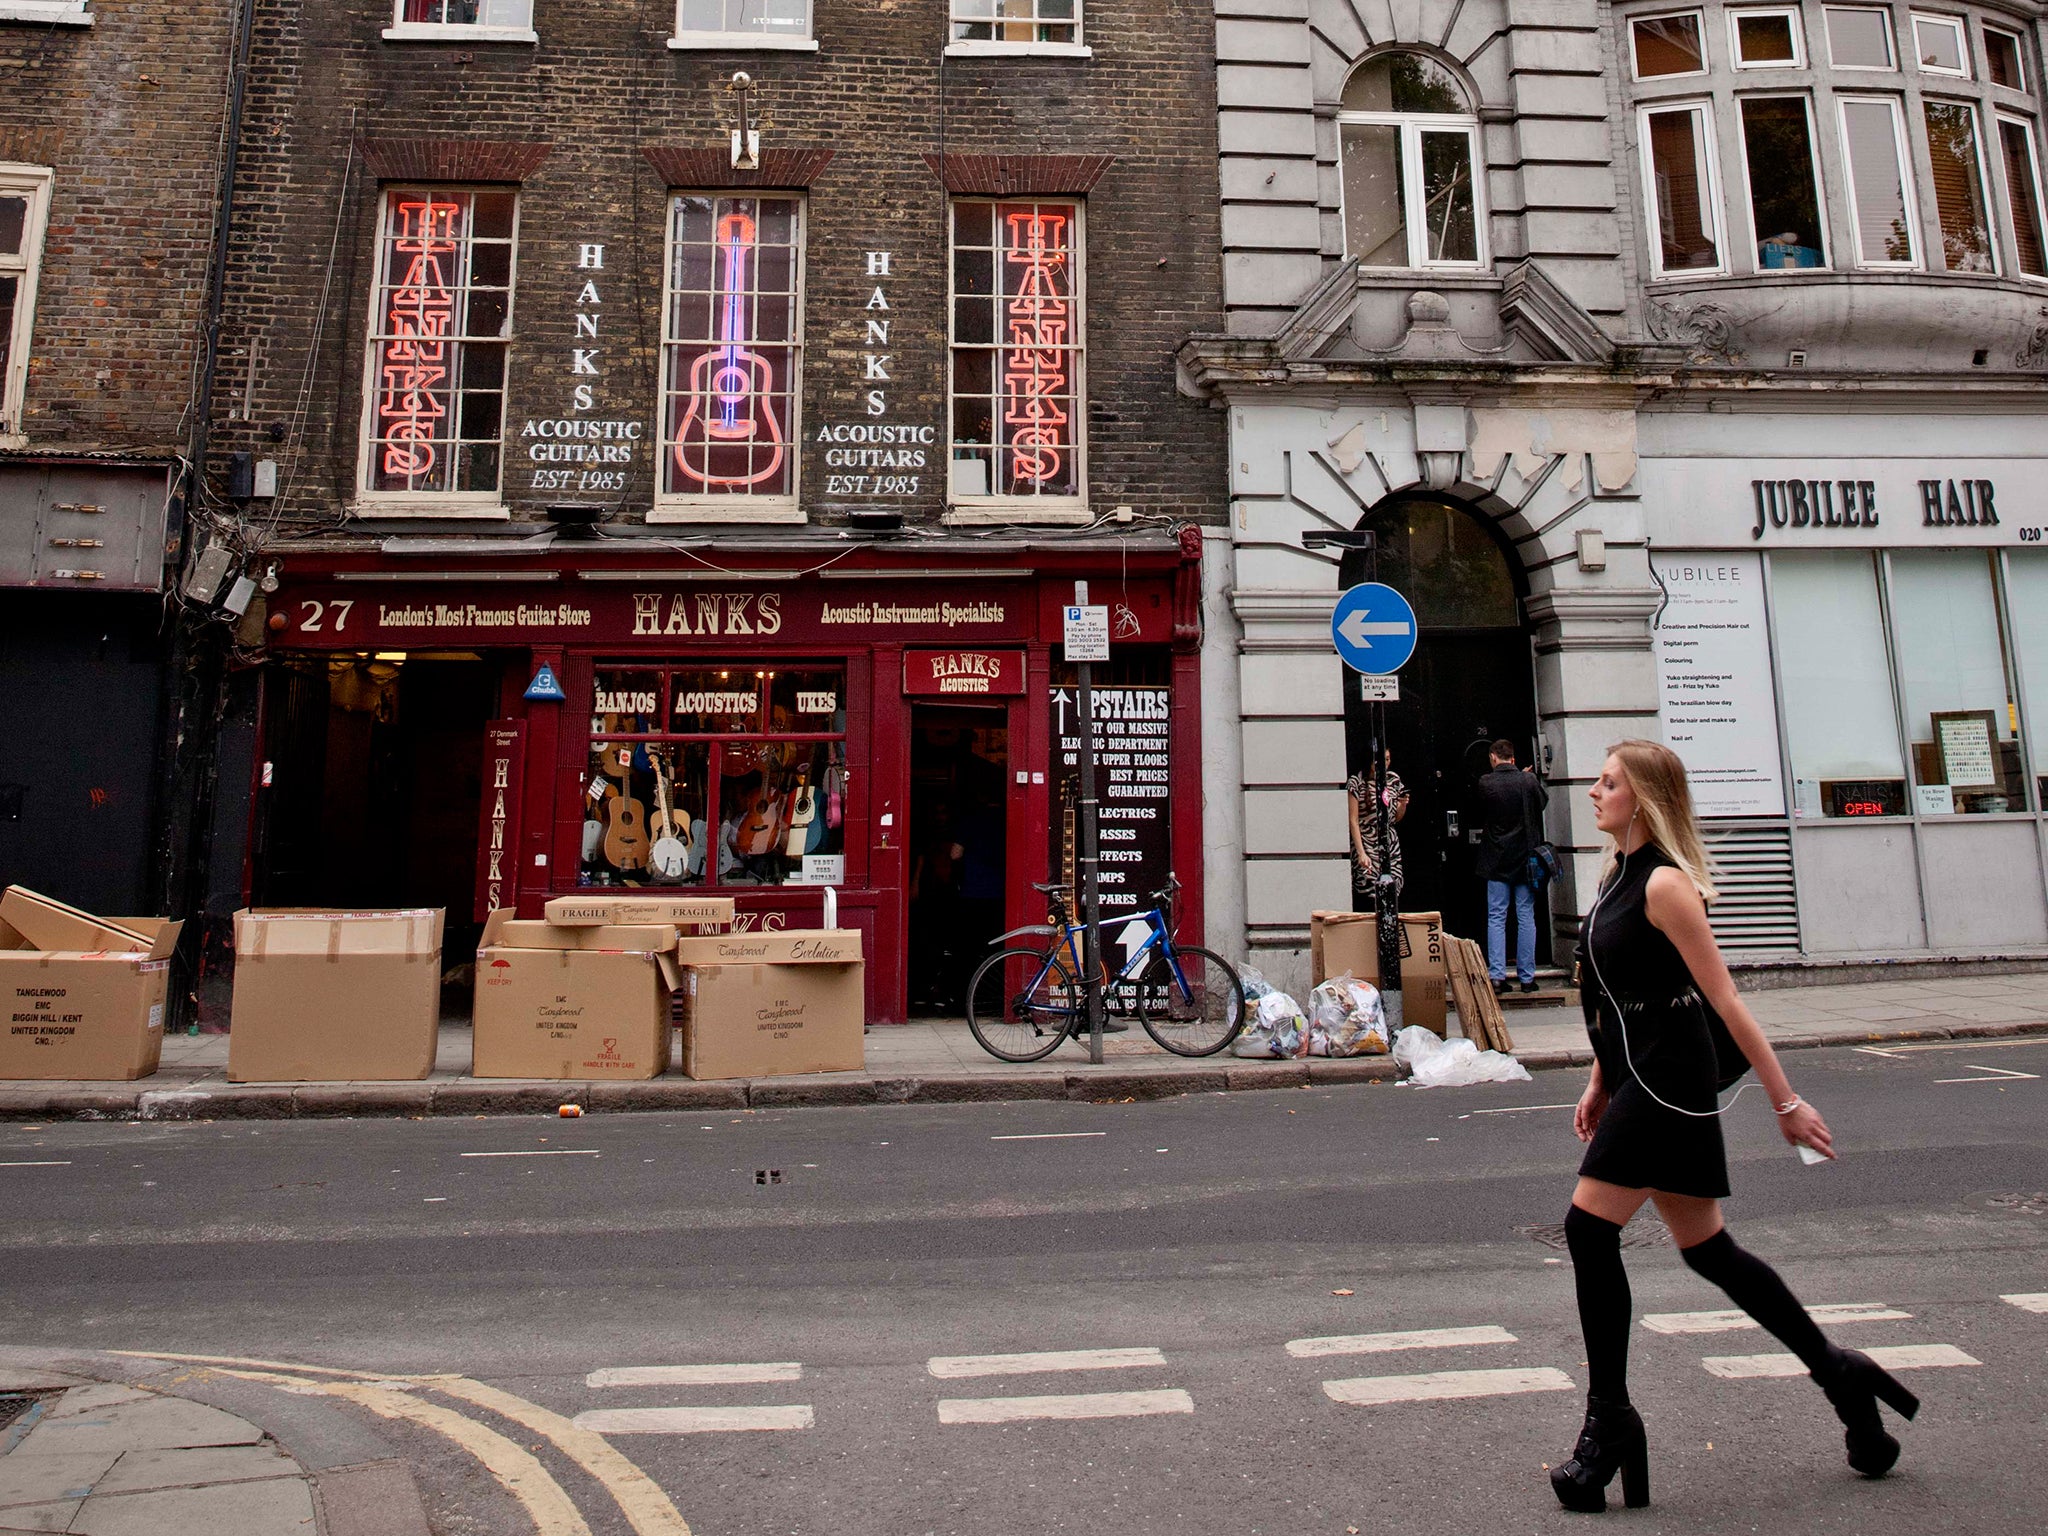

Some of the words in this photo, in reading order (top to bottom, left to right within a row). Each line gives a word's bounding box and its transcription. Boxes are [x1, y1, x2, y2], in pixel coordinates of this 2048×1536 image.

[572, 244, 605, 410] HANKS
[865, 251, 890, 416] HANKS
[381, 202, 459, 475] HANKS
[1005, 213, 1067, 480] HANKS
[521, 419, 642, 440] ACOUSTIC
[817, 425, 935, 444] ACOUSTIC
[529, 444, 631, 463] GUITARS
[825, 448, 926, 468] GUITARS
[531, 469, 575, 489] EST
[578, 470, 625, 490] 1985
[826, 475, 868, 494] EST
[873, 475, 919, 495] 1985
[1751, 479, 1879, 540] JUBILEE
[1917, 478, 2000, 528] HAIR
[2019, 527, 2041, 541] 020
[299, 600, 354, 632] 27
[379, 604, 434, 627] London's
[435, 605, 465, 627] Most
[466, 604, 516, 627] Famous
[517, 604, 557, 626] Guitar
[558, 604, 591, 626] Store
[632, 592, 782, 635] HANKS
[821, 602, 871, 624] Acoustic
[872, 602, 940, 624] Instrument
[941, 602, 1005, 627] Specialists
[931, 653, 1001, 678] HANKS
[532, 686, 556, 694] Chubb
[940, 678, 989, 692] ACOUSTICS
[595, 691, 656, 713] BANJOS
[675, 691, 757, 713] ACOUSTICS
[797, 691, 836, 713] UKES
[490, 730, 497, 738] 27
[497, 730, 519, 738] Denmark
[1106, 722, 1125, 734] OUR
[1129, 722, 1168, 735] MASSIVE
[496, 738, 511, 746] Street
[1108, 738, 1168, 750] DEPARTMENT
[1064, 753, 1077, 765] ON
[1102, 753, 1130, 765] UPPER
[1134, 753, 1168, 766] FLOORS
[1110, 769, 1133, 782] BEST
[1136, 769, 1168, 782] PRICES
[1108, 785, 1168, 798] GUARANTEED
[1836, 785, 1889, 805] NAILS
[1099, 807, 1156, 819] LECTRICS
[1844, 802, 1883, 815] OPEN
[488, 758, 509, 912] HANKS
[1099, 829, 1136, 840] ASSES
[1099, 851, 1143, 862] FFECTS
[1098, 893, 1137, 905] PARES
[562, 908, 608, 918] FRAGILE
[672, 907, 718, 917] FRAGILE
[1427, 922, 1440, 962] ARGE
[487, 978, 501, 986] KEEP
[16, 988, 66, 997] TANGLEWOOD
[555, 995, 566, 1003] EMC
[35, 1001, 51, 1010] EMC
[12, 1013, 38, 1022] BIGGIN
[40, 1014, 57, 1022] HILL
[62, 1014, 82, 1023] KENT
[11, 1026, 39, 1035] UNITED
[40, 1026, 75, 1035] KINGDOM
[556, 1022, 577, 1030] KINGDOM
[757, 1023, 777, 1031] UNITED
[778, 1022, 803, 1030] KINGDOM
[597, 1053, 621, 1061] FRAGILE
